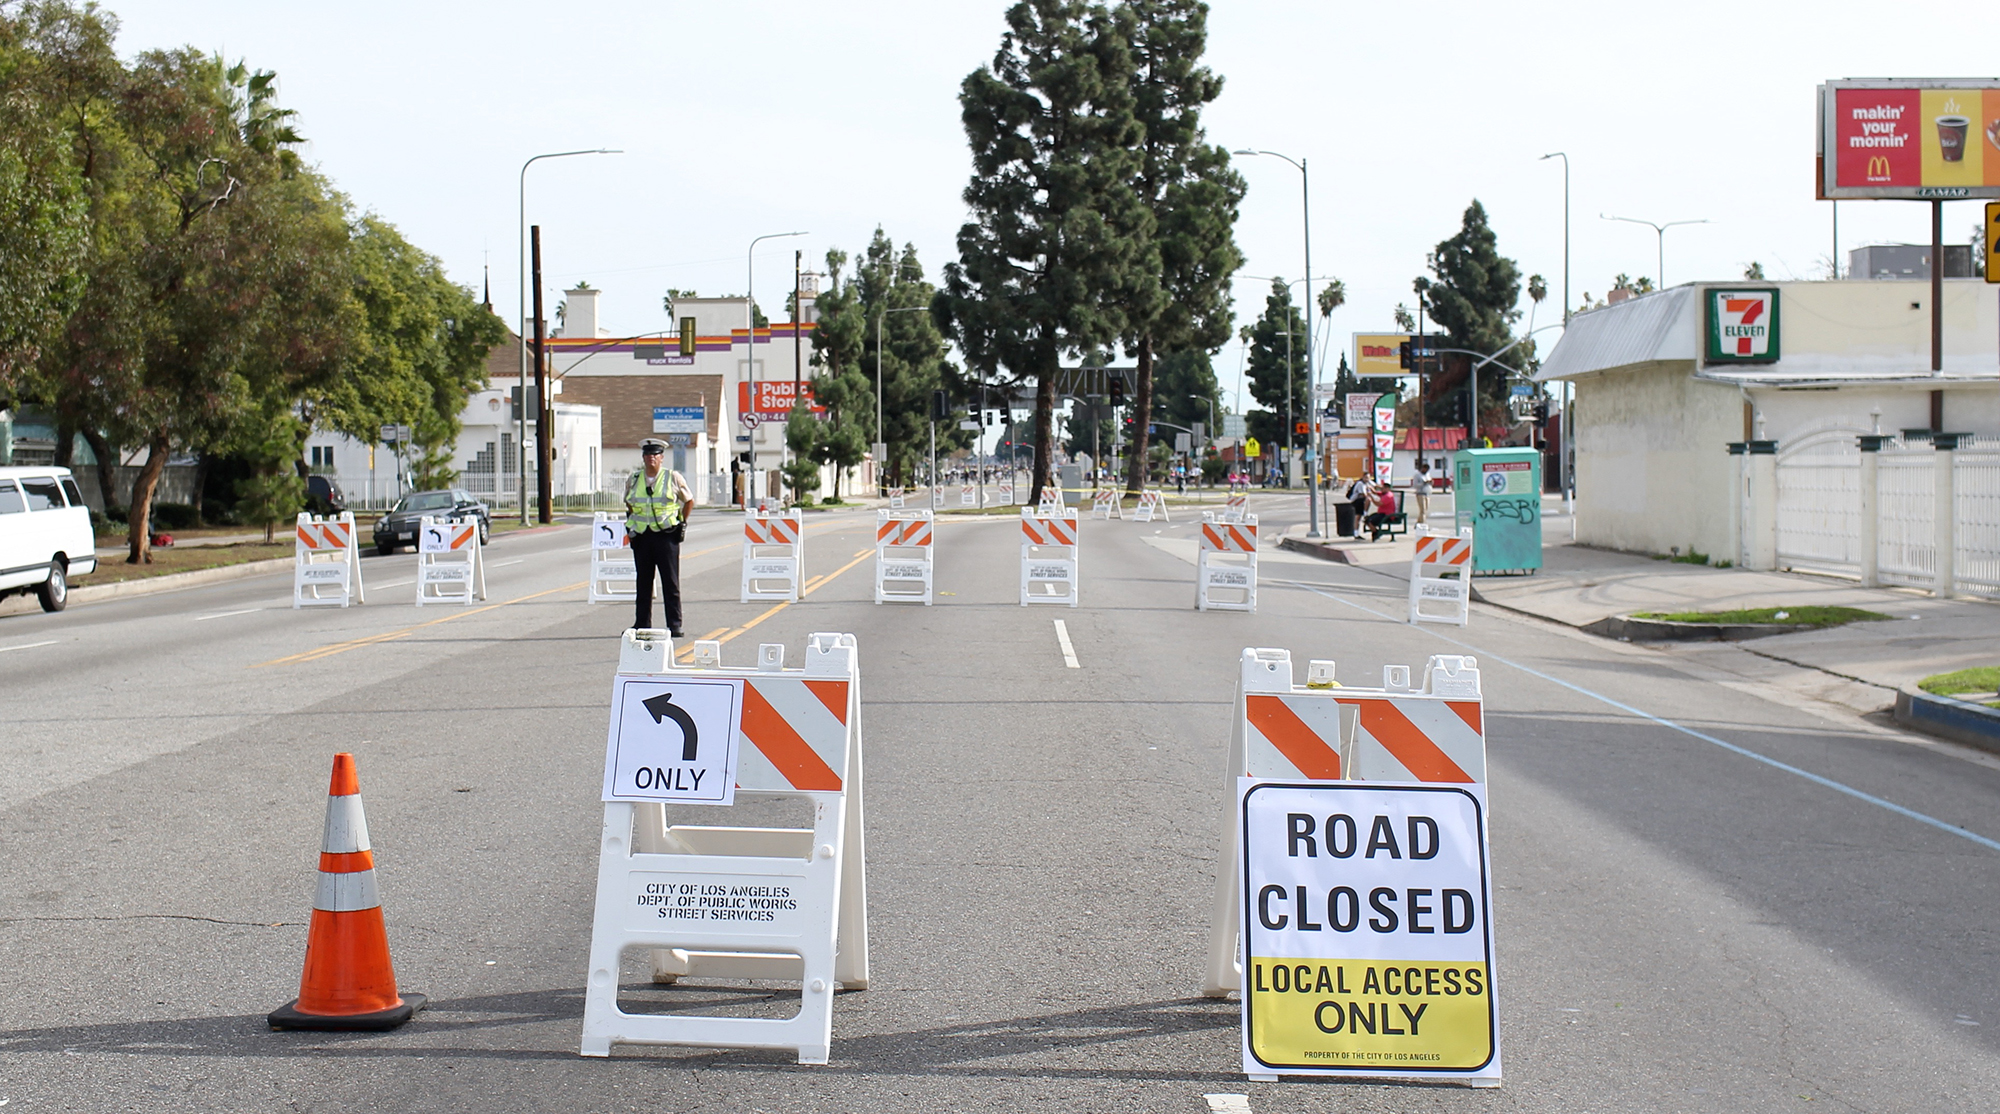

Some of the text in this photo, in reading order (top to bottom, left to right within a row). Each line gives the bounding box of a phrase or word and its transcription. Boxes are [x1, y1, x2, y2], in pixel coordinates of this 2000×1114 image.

[1852, 105, 1905, 120] makin'
[1862, 122, 1897, 136] your
[1850, 133, 1908, 148] mornin'
[1921, 188, 1967, 197] LAMAR
[762, 382, 809, 396] Publc
[635, 766, 707, 792] ONLY
[1286, 812, 1440, 861] ROAD
[646, 883, 790, 898] CITY OF LOS ANGELES
[637, 895, 797, 910] DEPT. OF PUBLIC WORKS
[1257, 884, 1475, 935] CLOSED
[658, 908, 775, 922] STREET SERVICES
[1255, 964, 1484, 996] LOCAL ACCESS
[1313, 1000, 1429, 1036] ONLY
[1304, 1051, 1340, 1060] PROPERTY
[1341, 1052, 1350, 1060] OF
[1352, 1052, 1365, 1060] THE
[1367, 1052, 1382, 1060] CITY
[1384, 1052, 1393, 1060] OF
[1410, 1053, 1441, 1061] ANGELES
